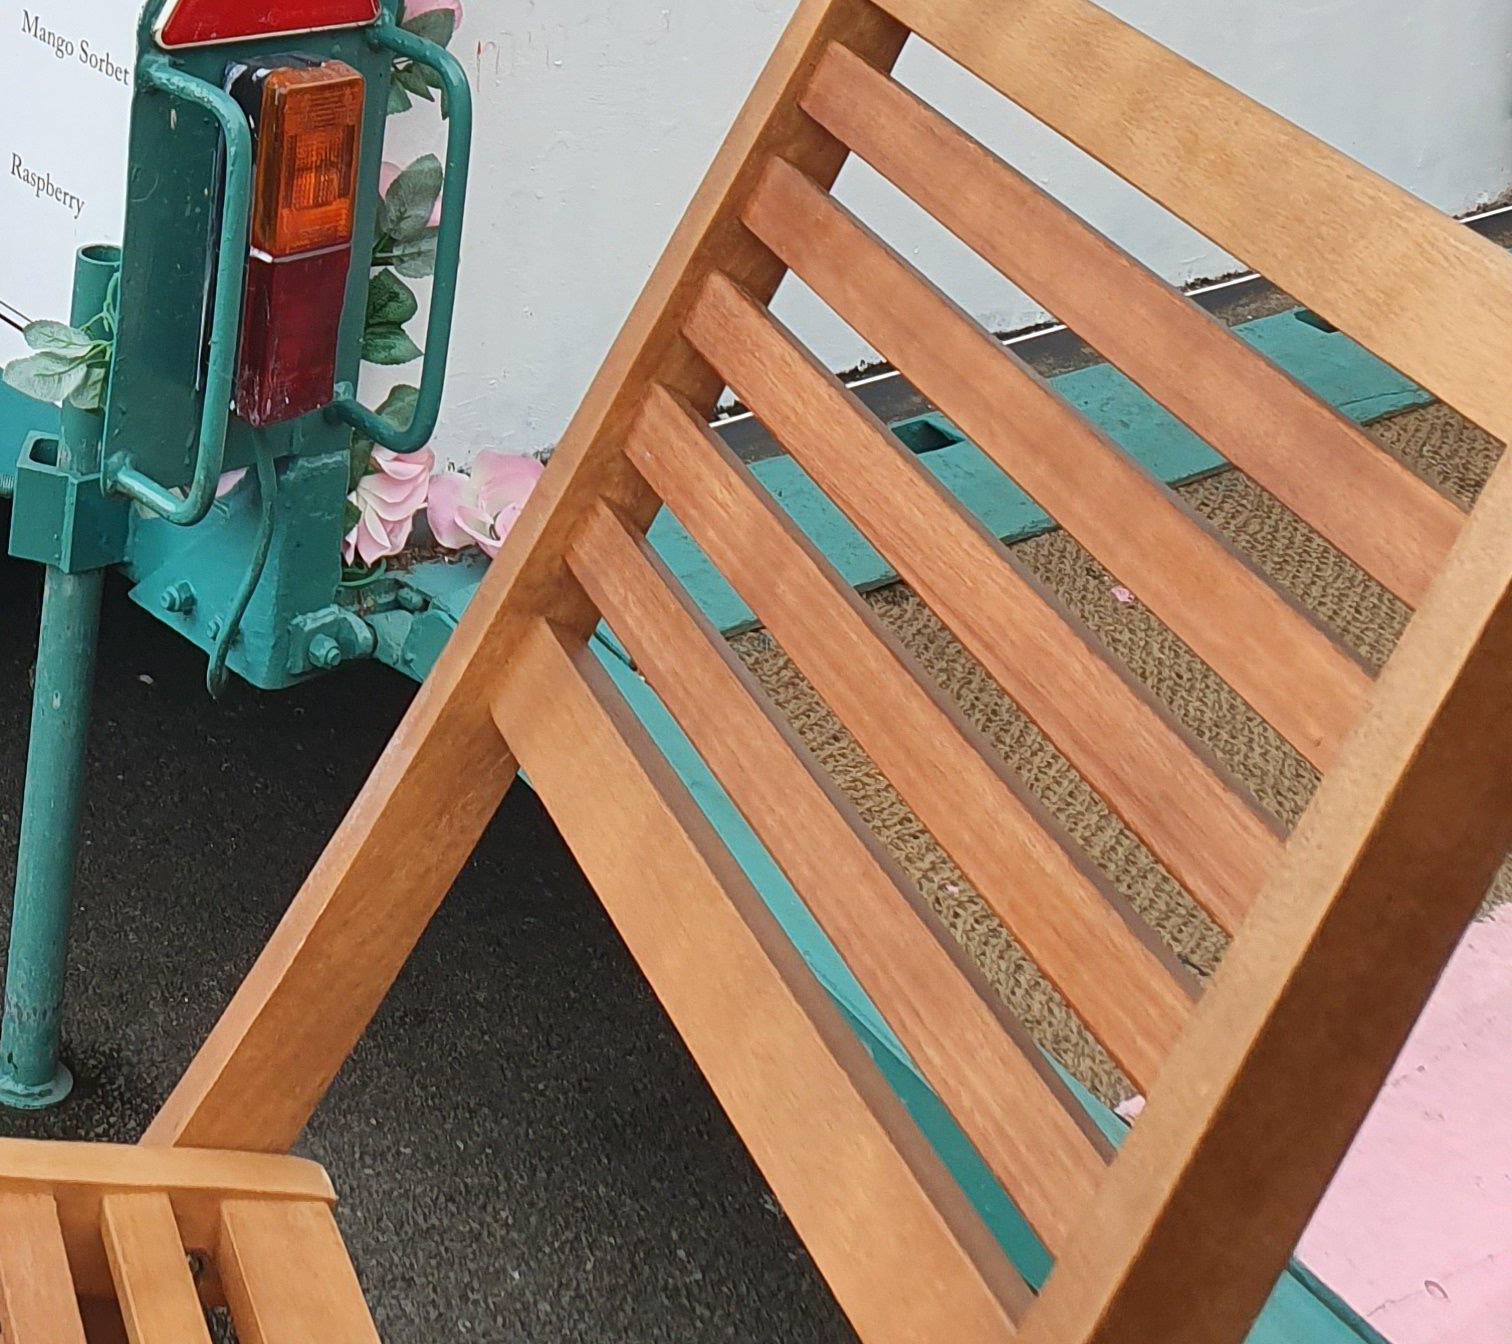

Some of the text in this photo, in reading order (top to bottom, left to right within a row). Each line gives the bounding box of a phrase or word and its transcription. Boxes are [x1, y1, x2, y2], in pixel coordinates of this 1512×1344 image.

[21, 9, 130, 87] Mango Sorbet
[11, 152, 85, 220] Raspberry
